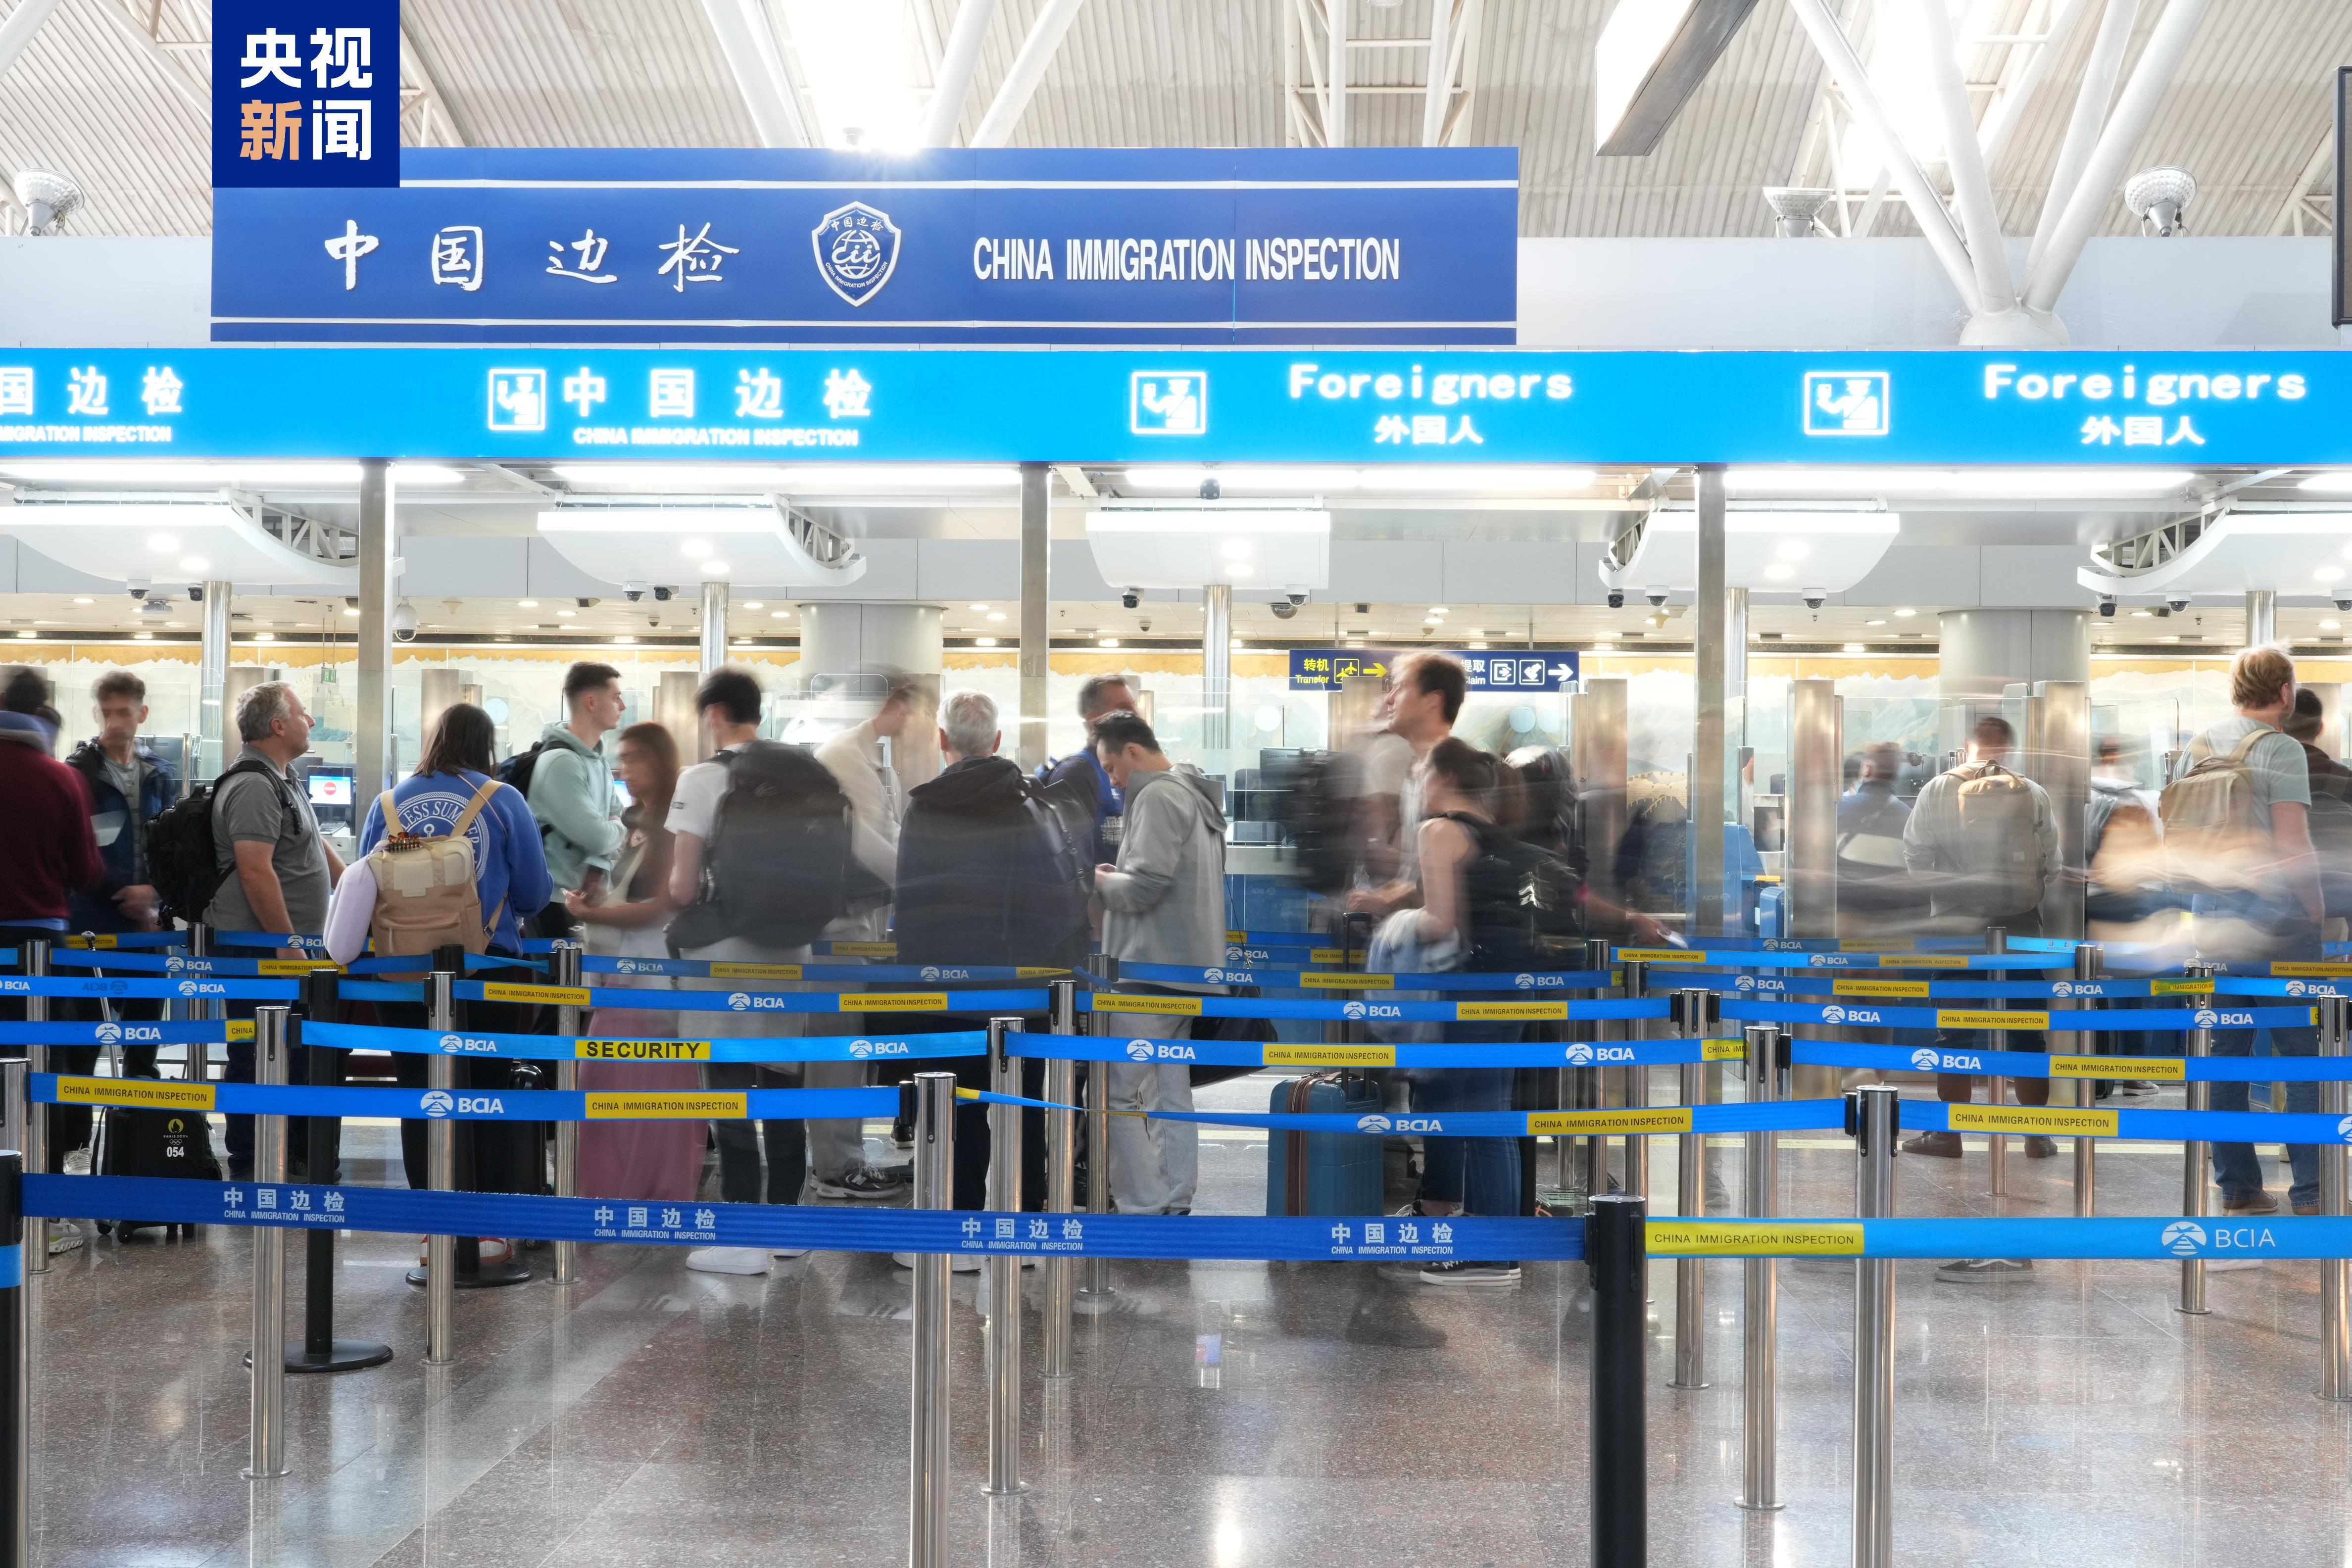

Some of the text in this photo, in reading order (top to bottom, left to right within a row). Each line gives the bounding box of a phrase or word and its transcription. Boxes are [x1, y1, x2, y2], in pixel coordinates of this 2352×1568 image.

[831, 217, 883, 231] 中国边检
[324, 220, 739, 293] 中国边检
[974, 237, 1399, 281] CHINA IMMIGRATION INSPECTION
[826, 261, 888, 288] CHINA IMMIGRATION INSPECTION
[0, 366, 183, 415] 国边检
[1289, 364, 1573, 404] Foreigners
[1984, 364, 2306, 405] Foreigners
[564, 367, 872, 418] 中国边检
[83, 426, 171, 441] INSPECTION
[574, 428, 858, 445] CHINA IMMIGRATION INSPECTION
[1374, 416, 1484, 444] 外国人
[2081, 416, 2205, 445] 外国人
[1304, 658, 1329, 671] 转机
[1461, 659, 1485, 672] 提取
[1295, 675, 1329, 684] Transfer
[433, 801, 480, 843] SUMER
[306, 938, 324, 947] BCI
[1247, 950, 1269, 959] BCIA
[187, 961, 212, 971] BCIA
[638, 963, 664, 973] BCIA
[2204, 962, 2227, 971] BCIA
[942, 970, 969, 979] BCIA
[1226, 973, 1253, 982] BCIA
[1537, 976, 1564, 986] BCIA
[4, 981, 30, 990] BCIA
[199, 983, 225, 993] BCIA
[1757, 980, 1785, 990] BCIA
[2075, 985, 2103, 995] BCIA
[2308, 984, 2336, 995] BCIA
[508, 989, 548, 998] IMMIGRATION
[753, 997, 784, 1008] BCIA
[1118, 1000, 1159, 1008] IMMIGRATION
[1369, 1006, 1401, 1017] BCIA
[1848, 1011, 1881, 1022] BCIA
[2221, 1013, 2254, 1025] BCIA
[125, 1027, 161, 1040] BCIA
[465, 1040, 497, 1052] BCIA
[586, 1041, 700, 1059] SECURITY
[875, 1041, 908, 1054] BCIA
[1158, 1046, 1196, 1060] BCIA
[1597, 1048, 1634, 1061] BCIA
[1943, 1055, 1981, 1070] BCIA
[2055, 1063, 2178, 1074] CHINA IMMIGRATION INSPECTION
[63, 1085, 207, 1102] CHINA IMMIGRATION INSPECTION
[458, 1098, 504, 1114] BCIA
[591, 1102, 738, 1111] CHINA IMMIGRATION INSPECTION
[1396, 1119, 1443, 1132] BCIA
[1566, 1119, 1628, 1127] IMMIGRATION
[1630, 1117, 1684, 1126] INSPECTION
[1956, 1114, 2109, 1128] CHINA IMMIGRATION INSPECTION
[167, 1146, 184, 1157] 054
[224, 1187, 344, 1212] 中国边检
[224, 1210, 344, 1223] CHINA IMMIGRATION INSPECTION
[594, 1206, 716, 1229] 中国边检
[594, 1228, 716, 1240] CHINA IMMIGRATION INSPECTION
[962, 1218, 1083, 1240] 中国边检
[1331, 1223, 1453, 1244] 中国边检
[1655, 1234, 1854, 1245] CHINA IMMIGRATION INSPECTION
[2215, 1228, 2276, 1247] BCIA
[962, 1240, 1083, 1251] CHINA IMMIGRATION INSPECTION
[1331, 1246, 1353, 1254] CHINA
